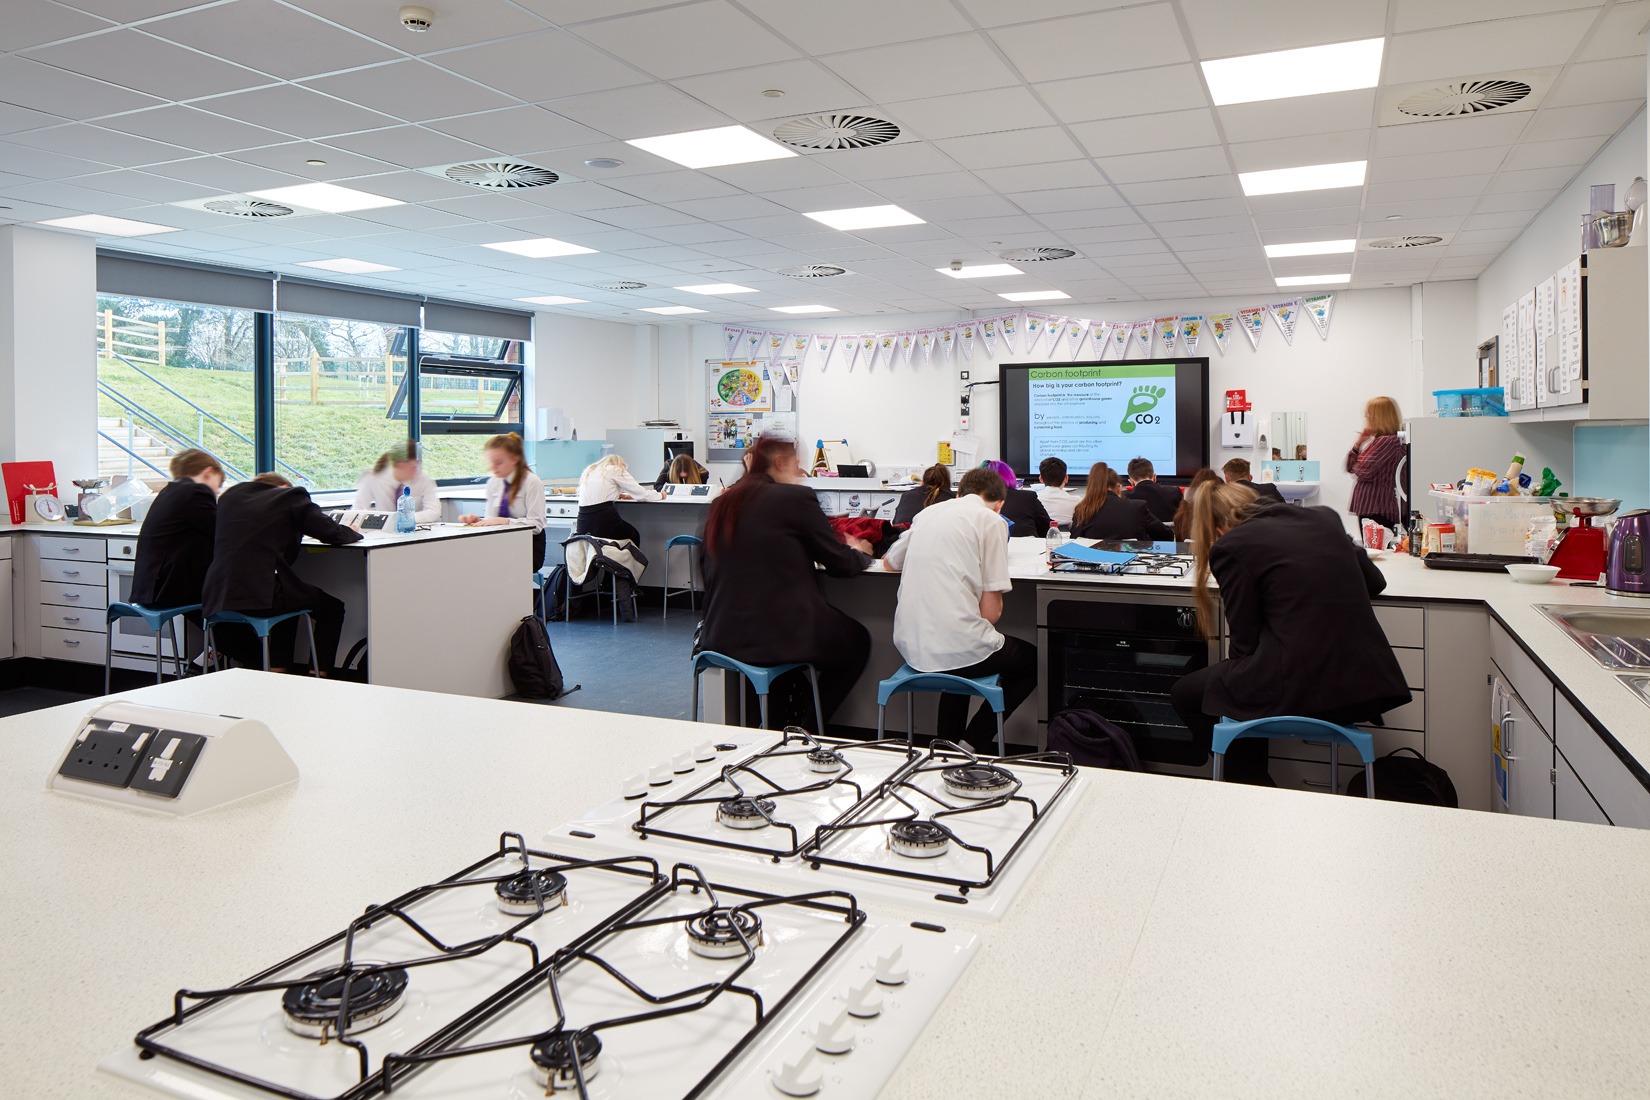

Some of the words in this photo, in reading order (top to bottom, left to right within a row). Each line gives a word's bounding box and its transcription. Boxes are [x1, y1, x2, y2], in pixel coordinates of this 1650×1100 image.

[1272, 301, 1293, 309] VITAMIN
[1030, 370, 1063, 378] Carbon
[1065, 369, 1101, 379] footprint
[1034, 411, 1045, 420] by
